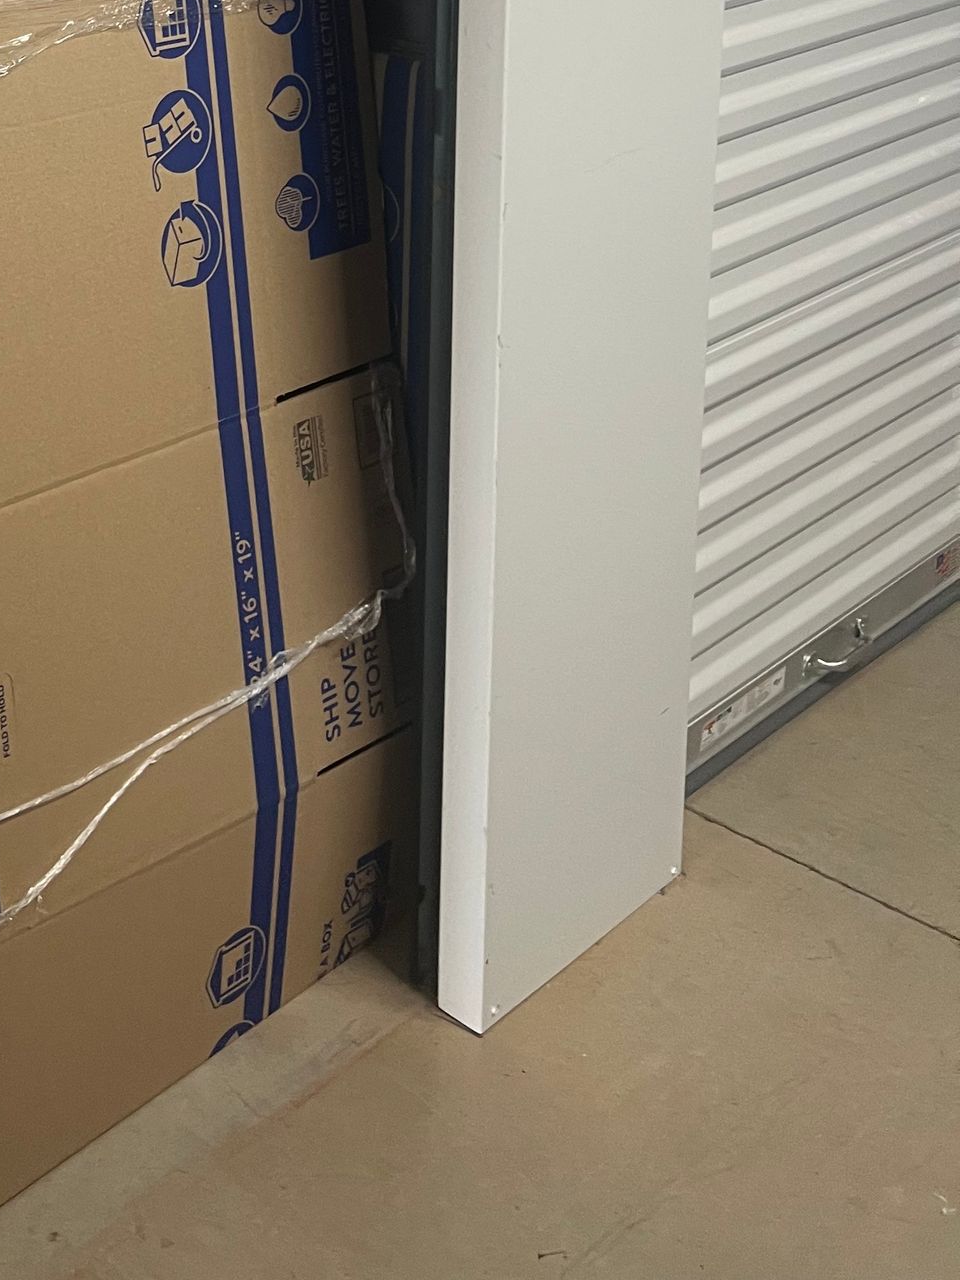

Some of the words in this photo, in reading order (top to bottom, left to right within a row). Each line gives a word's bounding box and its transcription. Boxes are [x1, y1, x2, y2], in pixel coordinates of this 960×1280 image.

[297, 419, 314, 465] USA
[234, 531, 252, 564] 19"
[243, 567, 255, 582] x
[240, 591, 258, 624] 16"
[249, 626, 261, 641] x
[339, 642, 364, 728] MOVE
[362, 629, 385, 719] STORE
[0, 715, 8, 730] TO
[321, 677, 342, 743] SHIP
[1, 731, 11, 759] FOLD
[320, 919, 333, 954] BOX
